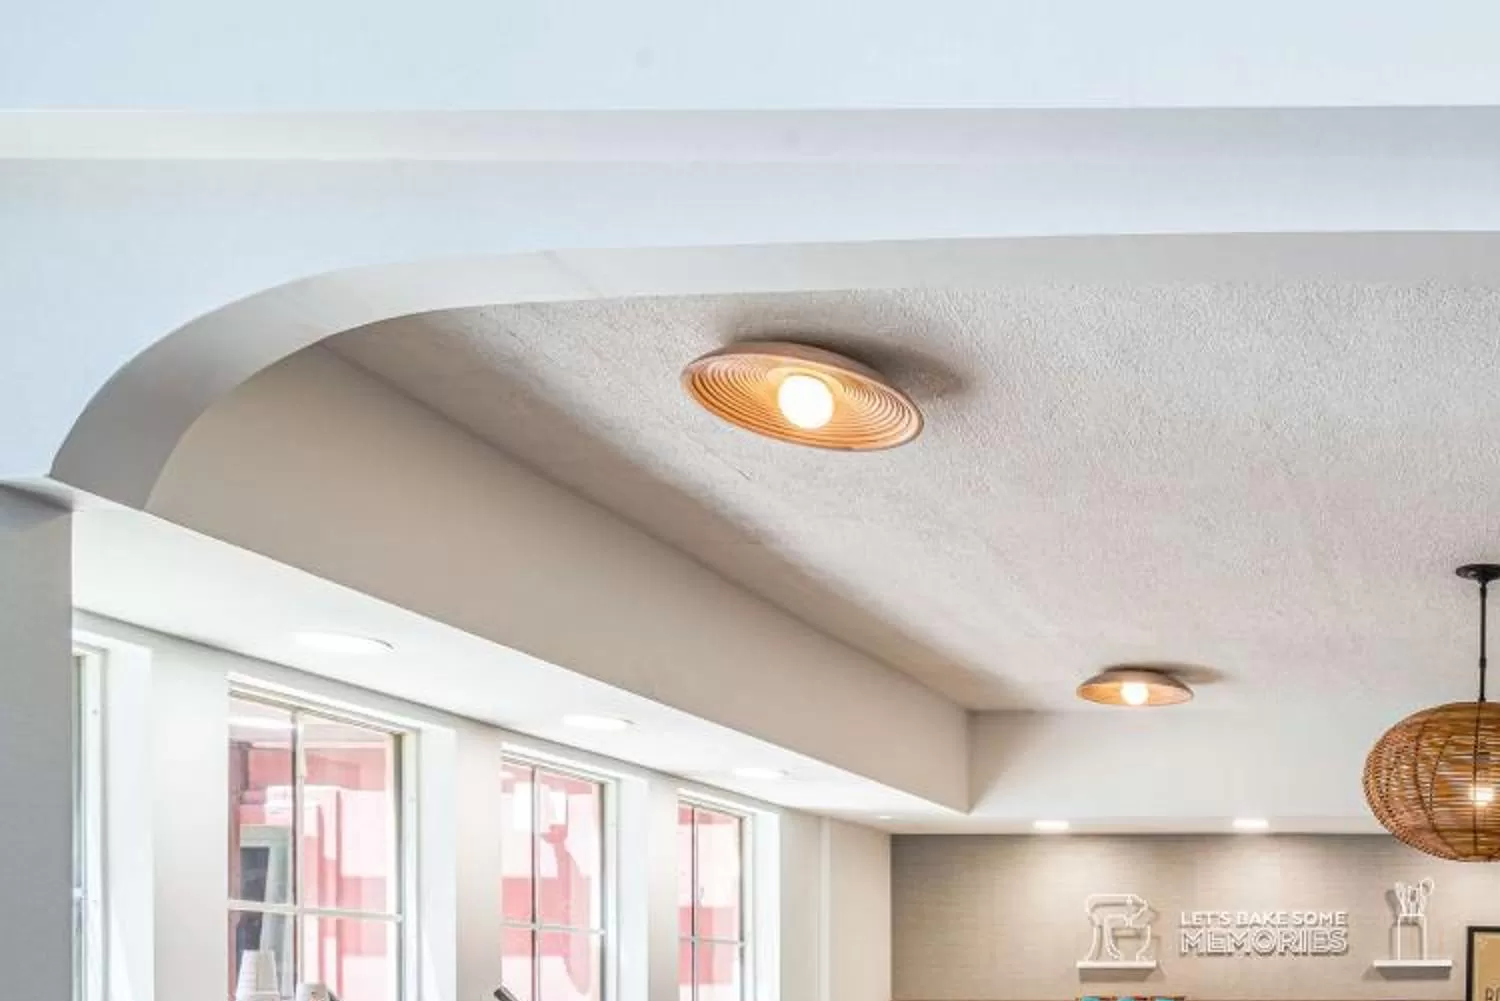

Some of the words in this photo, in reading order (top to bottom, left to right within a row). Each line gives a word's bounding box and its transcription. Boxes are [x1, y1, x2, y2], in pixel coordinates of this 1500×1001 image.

[1181, 911, 1230, 928] LET'S
[1236, 911, 1288, 928] BAKE
[1293, 911, 1348, 928] SOME
[1180, 928, 1349, 956] MEMORIES
